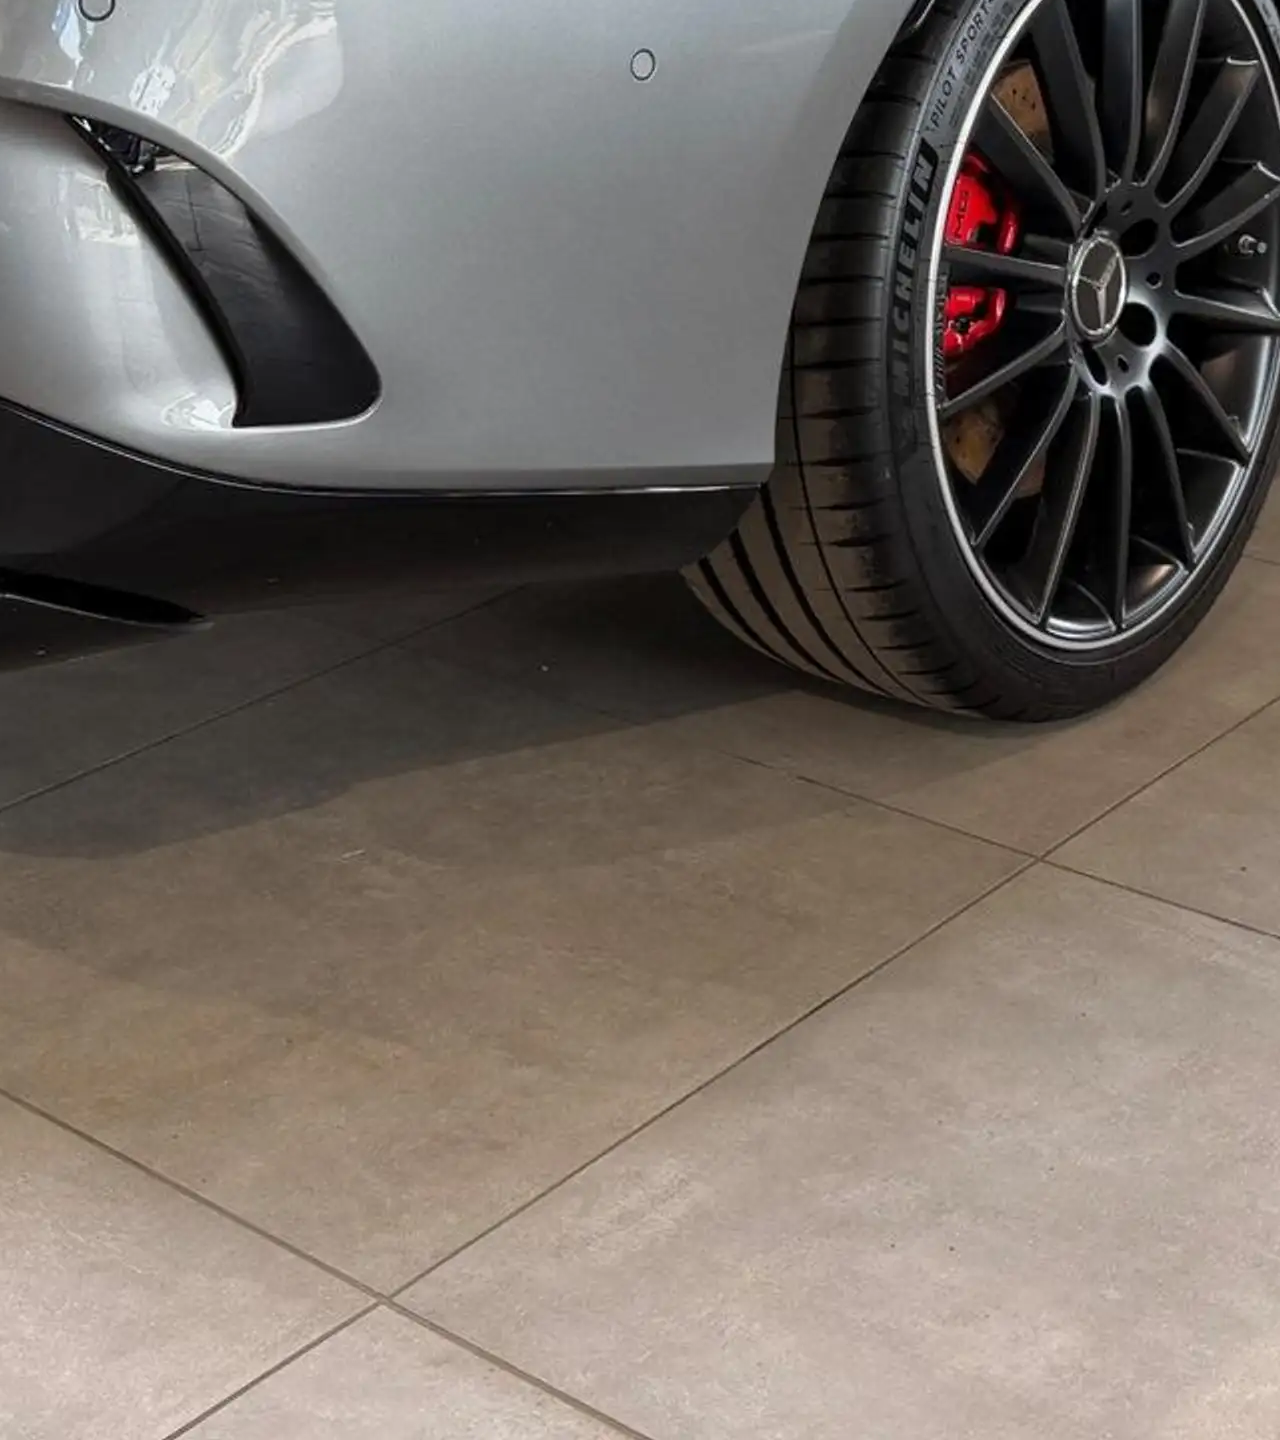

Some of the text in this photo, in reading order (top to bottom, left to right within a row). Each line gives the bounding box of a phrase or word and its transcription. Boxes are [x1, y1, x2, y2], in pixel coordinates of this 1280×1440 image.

[930, 68, 957, 128] PILOT
[956, 2, 990, 64] SPORT
[892, 137, 937, 398] MICHELIN
